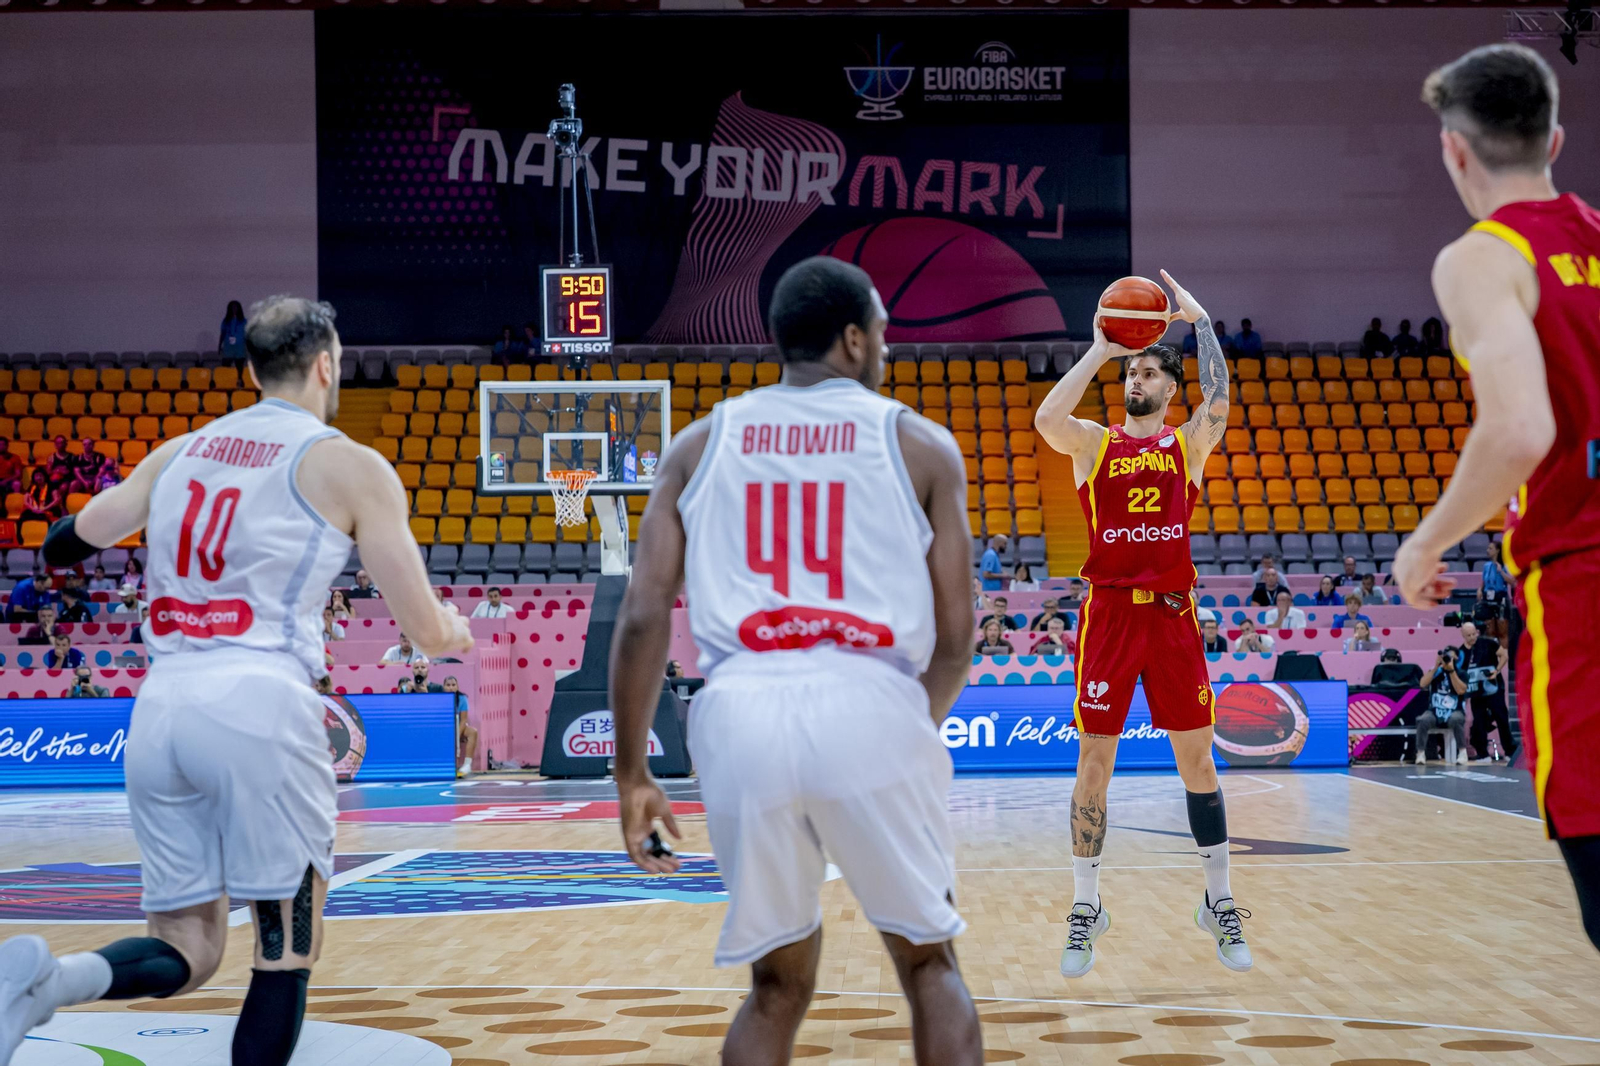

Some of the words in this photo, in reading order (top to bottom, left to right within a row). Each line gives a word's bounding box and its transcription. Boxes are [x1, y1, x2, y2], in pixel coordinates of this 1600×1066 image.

[982, 50, 1008, 63] FIBA
[924, 67, 1066, 90] EUROBASKET
[448, 128, 648, 193] MAKE
[661, 141, 839, 206] YOUR
[849, 155, 1046, 219] MARK
[561, 276, 604, 296] 9:50
[569, 301, 601, 334] 15
[561, 342, 612, 354] TISSOT
[742, 422, 856, 455] BALDWIN
[1108, 450, 1178, 478] ESPAÑA
[1127, 487, 1162, 513] 22
[176, 478, 241, 581] 10
[745, 481, 845, 599] 44
[1103, 523, 1183, 544] endesa
[580, 718, 616, 734] 百岁
[1006, 716, 1057, 746] feel
[40, 732, 88, 760] the
